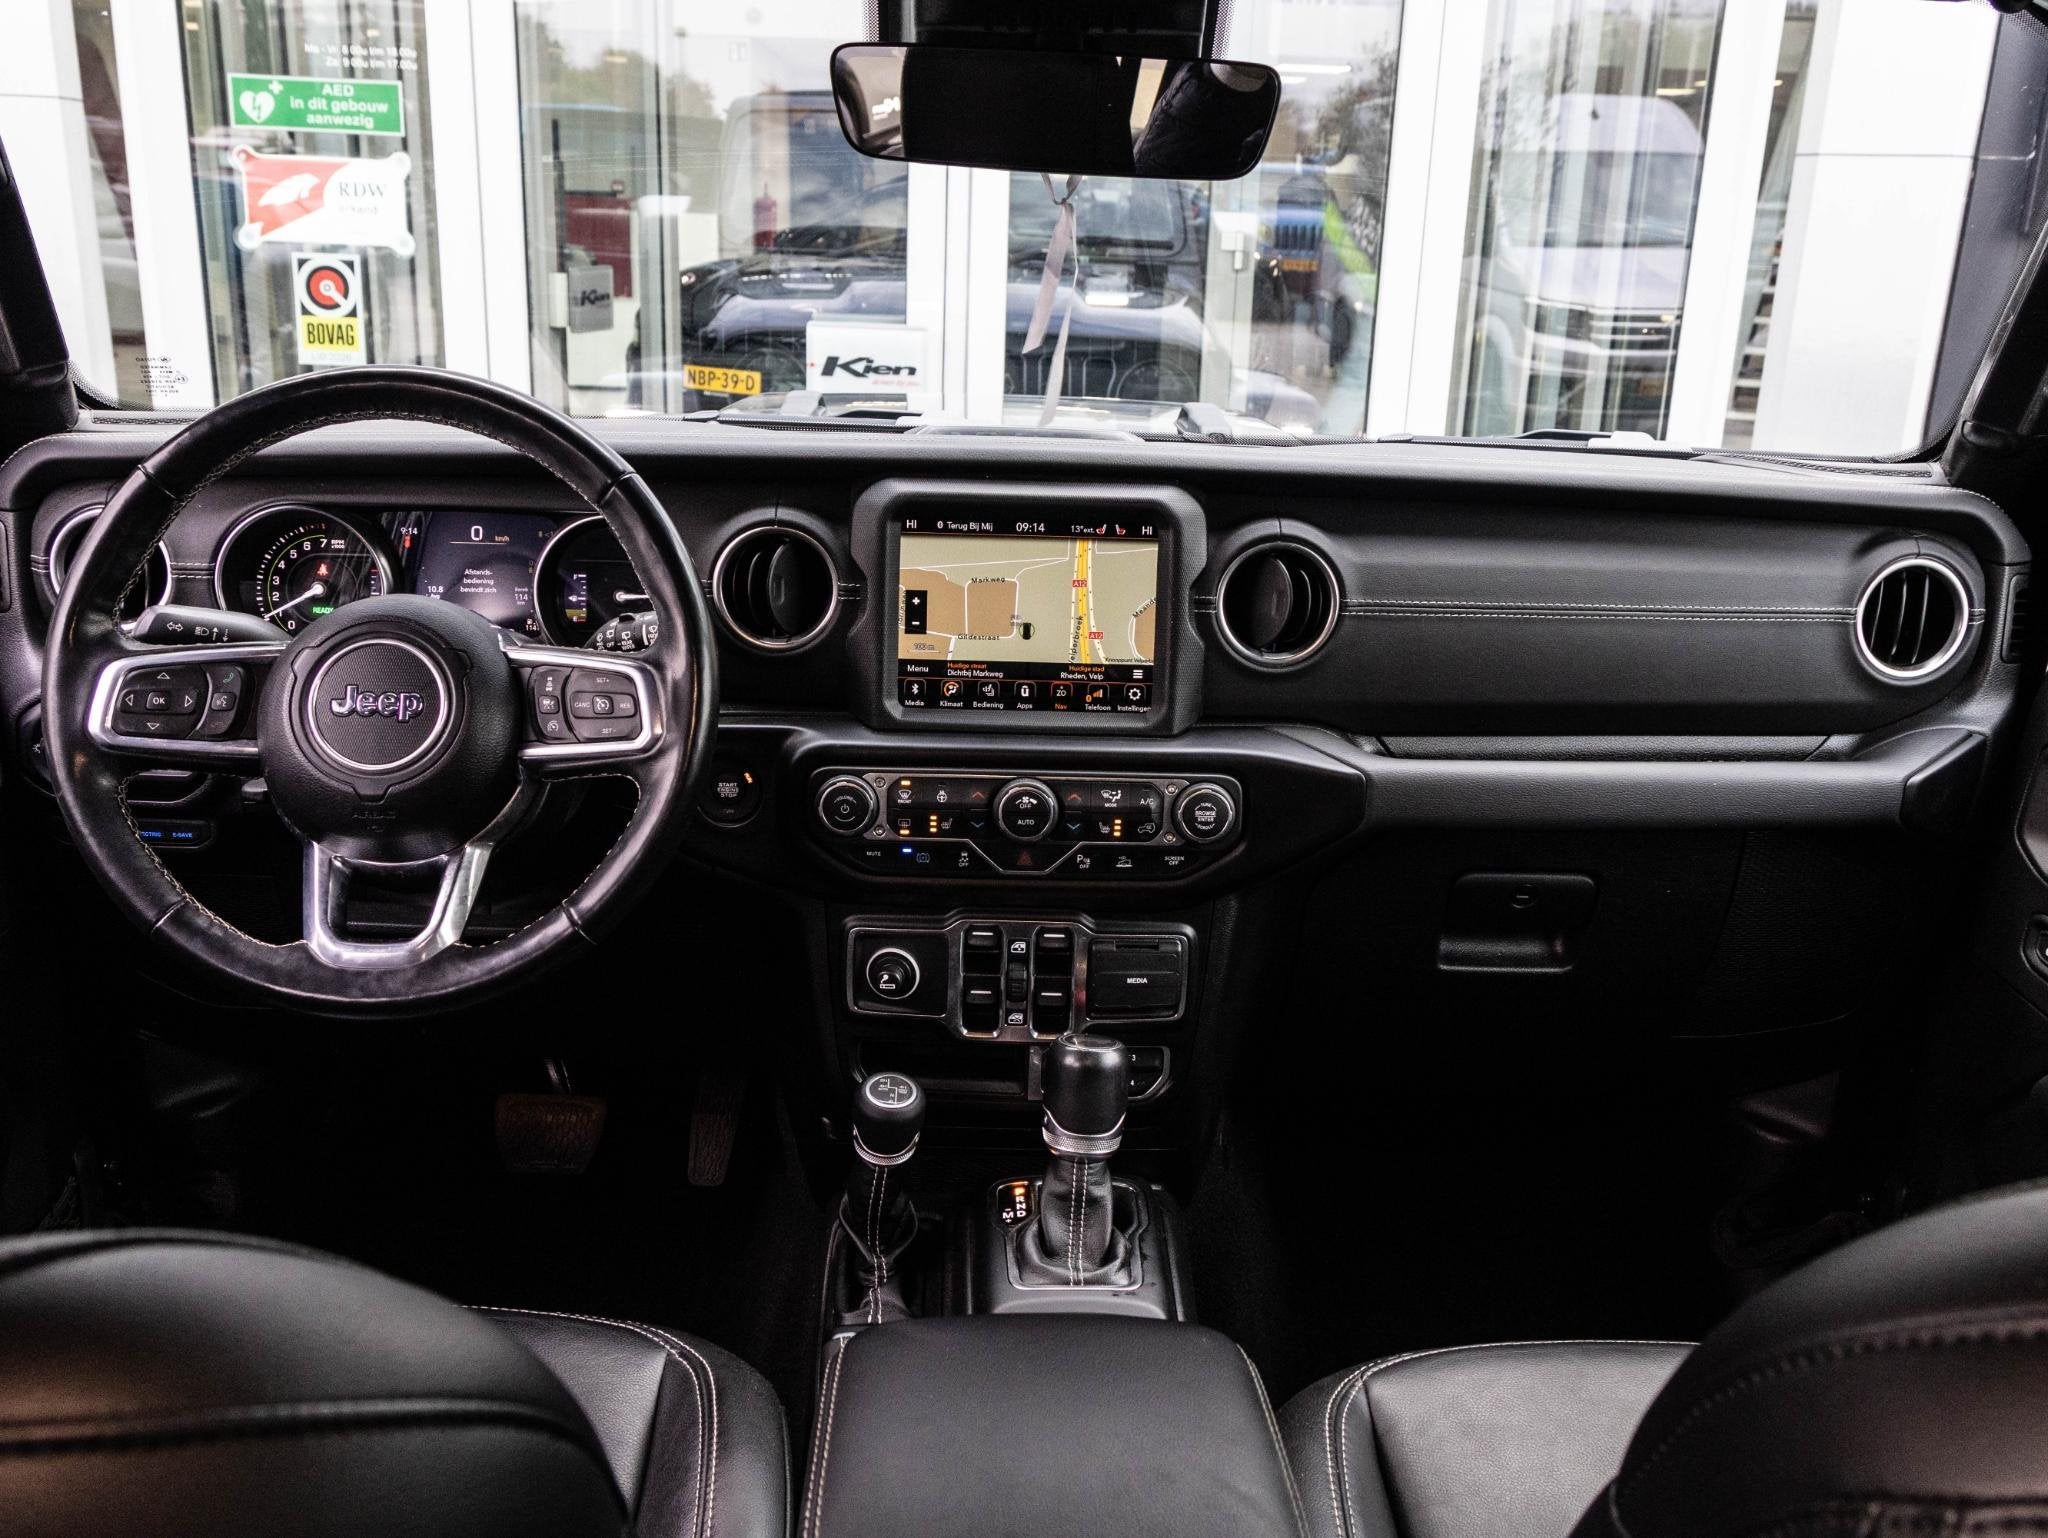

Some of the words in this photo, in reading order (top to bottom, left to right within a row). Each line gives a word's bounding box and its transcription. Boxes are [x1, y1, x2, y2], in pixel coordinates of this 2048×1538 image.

[322, 84, 355, 97] AED
[308, 96, 328, 111] dit
[331, 100, 389, 114] gebouw
[306, 112, 374, 129] aanwezig
[338, 182, 386, 197] RDW
[307, 322, 355, 346] BOVAG
[820, 356, 917, 378] Kien
[687, 368, 755, 392] NBP-39-D
[906, 520, 917, 529] HI
[947, 521, 968, 531] Terug
[969, 522, 980, 532] Bij
[981, 522, 994, 532] Mij
[1016, 522, 1046, 533] 09:14
[1142, 526, 1153, 536] HI
[470, 526, 483, 541] 0
[304, 542, 311, 550] 6
[320, 538, 328, 548] 7
[290, 550, 297, 559] 5
[278, 560, 286, 569] 4
[273, 576, 280, 585] 3
[272, 592, 280, 601] 2
[288, 621, 296, 629] 0
[908, 665, 929, 673] Menu
[948, 669, 972, 678] Dichtbij
[973, 670, 1004, 679] Markweg
[1060, 672, 1088, 680] Rheden,
[331, 685, 424, 723] Jeep
[973, 701, 1004, 709] Bediening
[1017, 702, 1033, 710] Apps
[1140, 798, 1154, 806] A/C
